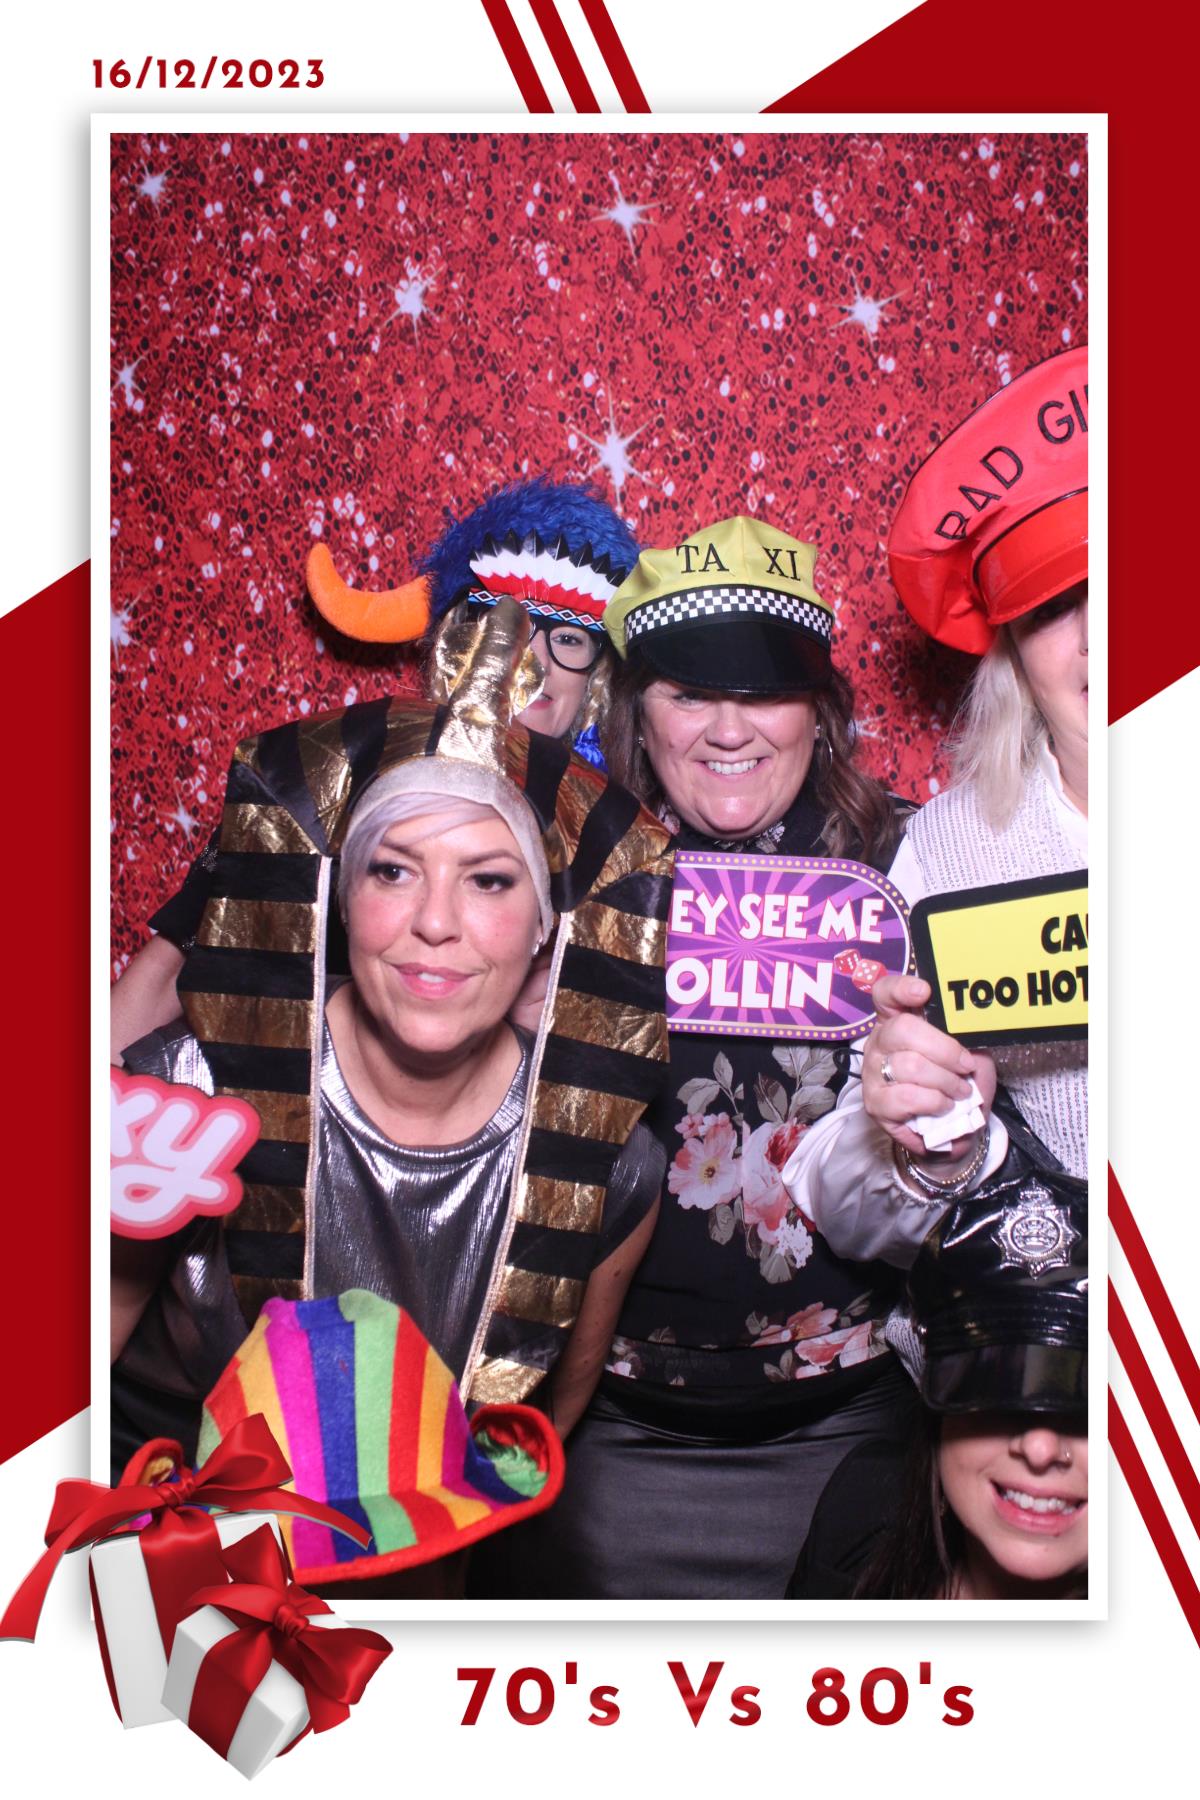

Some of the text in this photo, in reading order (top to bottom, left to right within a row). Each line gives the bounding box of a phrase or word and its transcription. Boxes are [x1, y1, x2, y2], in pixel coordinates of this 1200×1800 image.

[1037, 384, 1088, 444] GI
[738, 893, 809, 940] SEE
[817, 896, 885, 944] ME
[1041, 913, 1088, 954] CA
[947, 976, 1019, 1011] TOO
